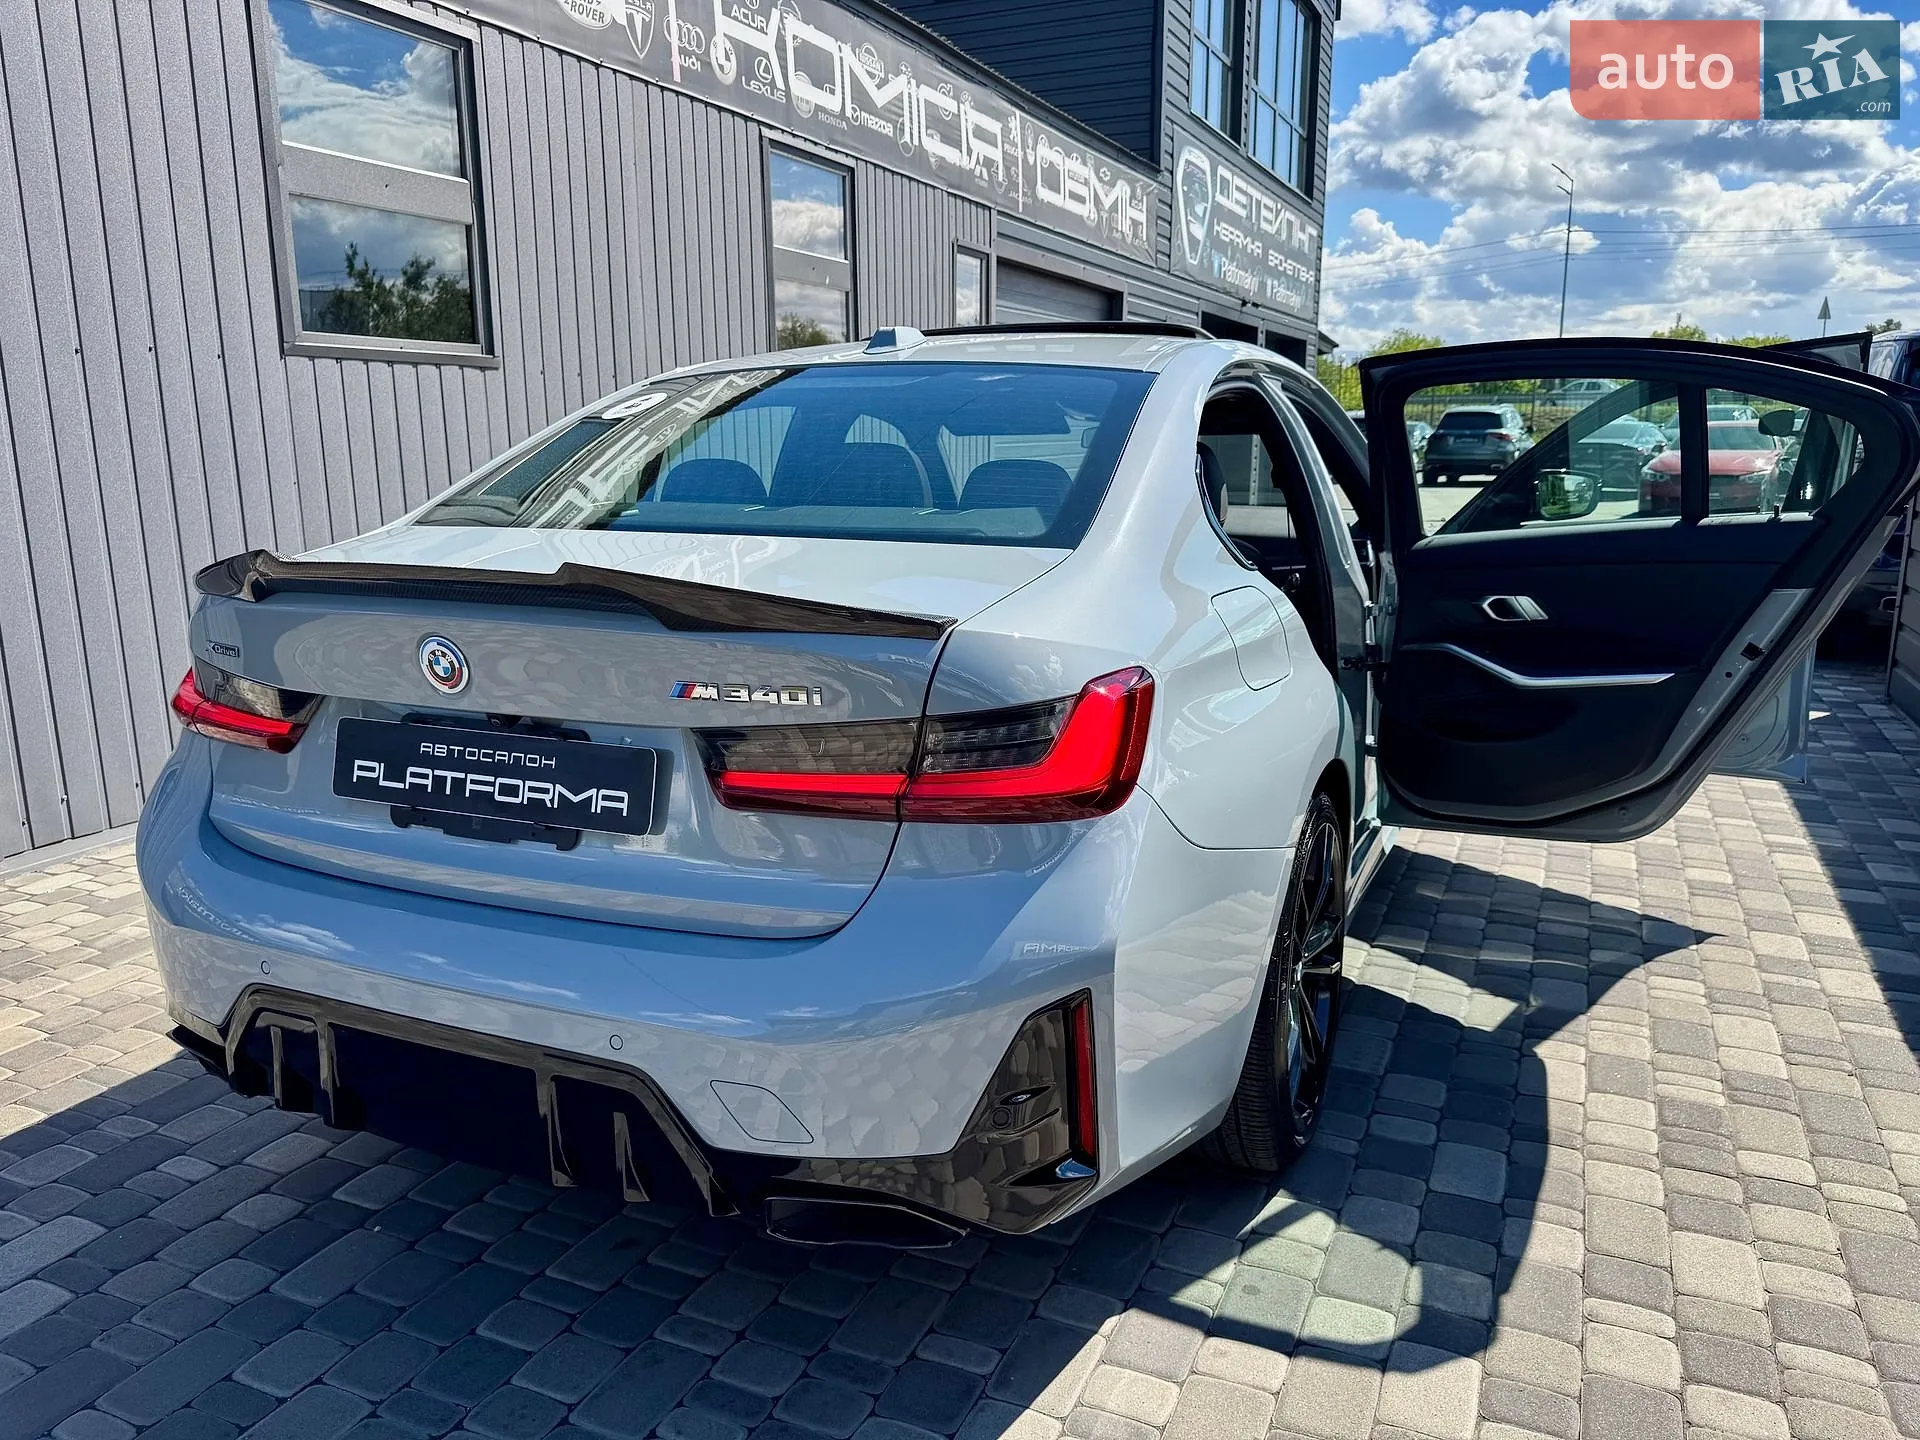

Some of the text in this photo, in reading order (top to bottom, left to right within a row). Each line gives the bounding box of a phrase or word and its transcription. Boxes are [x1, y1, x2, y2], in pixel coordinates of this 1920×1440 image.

[570, 1, 605, 24] ROVER
[731, 4, 768, 32] ACUR
[742, 75, 786, 103] LEXUS
[818, 111, 848, 130] HONDA
[428, 650, 453, 662] BMW
[689, 681, 822, 706] M340i
[419, 742, 556, 769] АВТОСАЛОН
[353, 759, 628, 817] PLATFORMA
